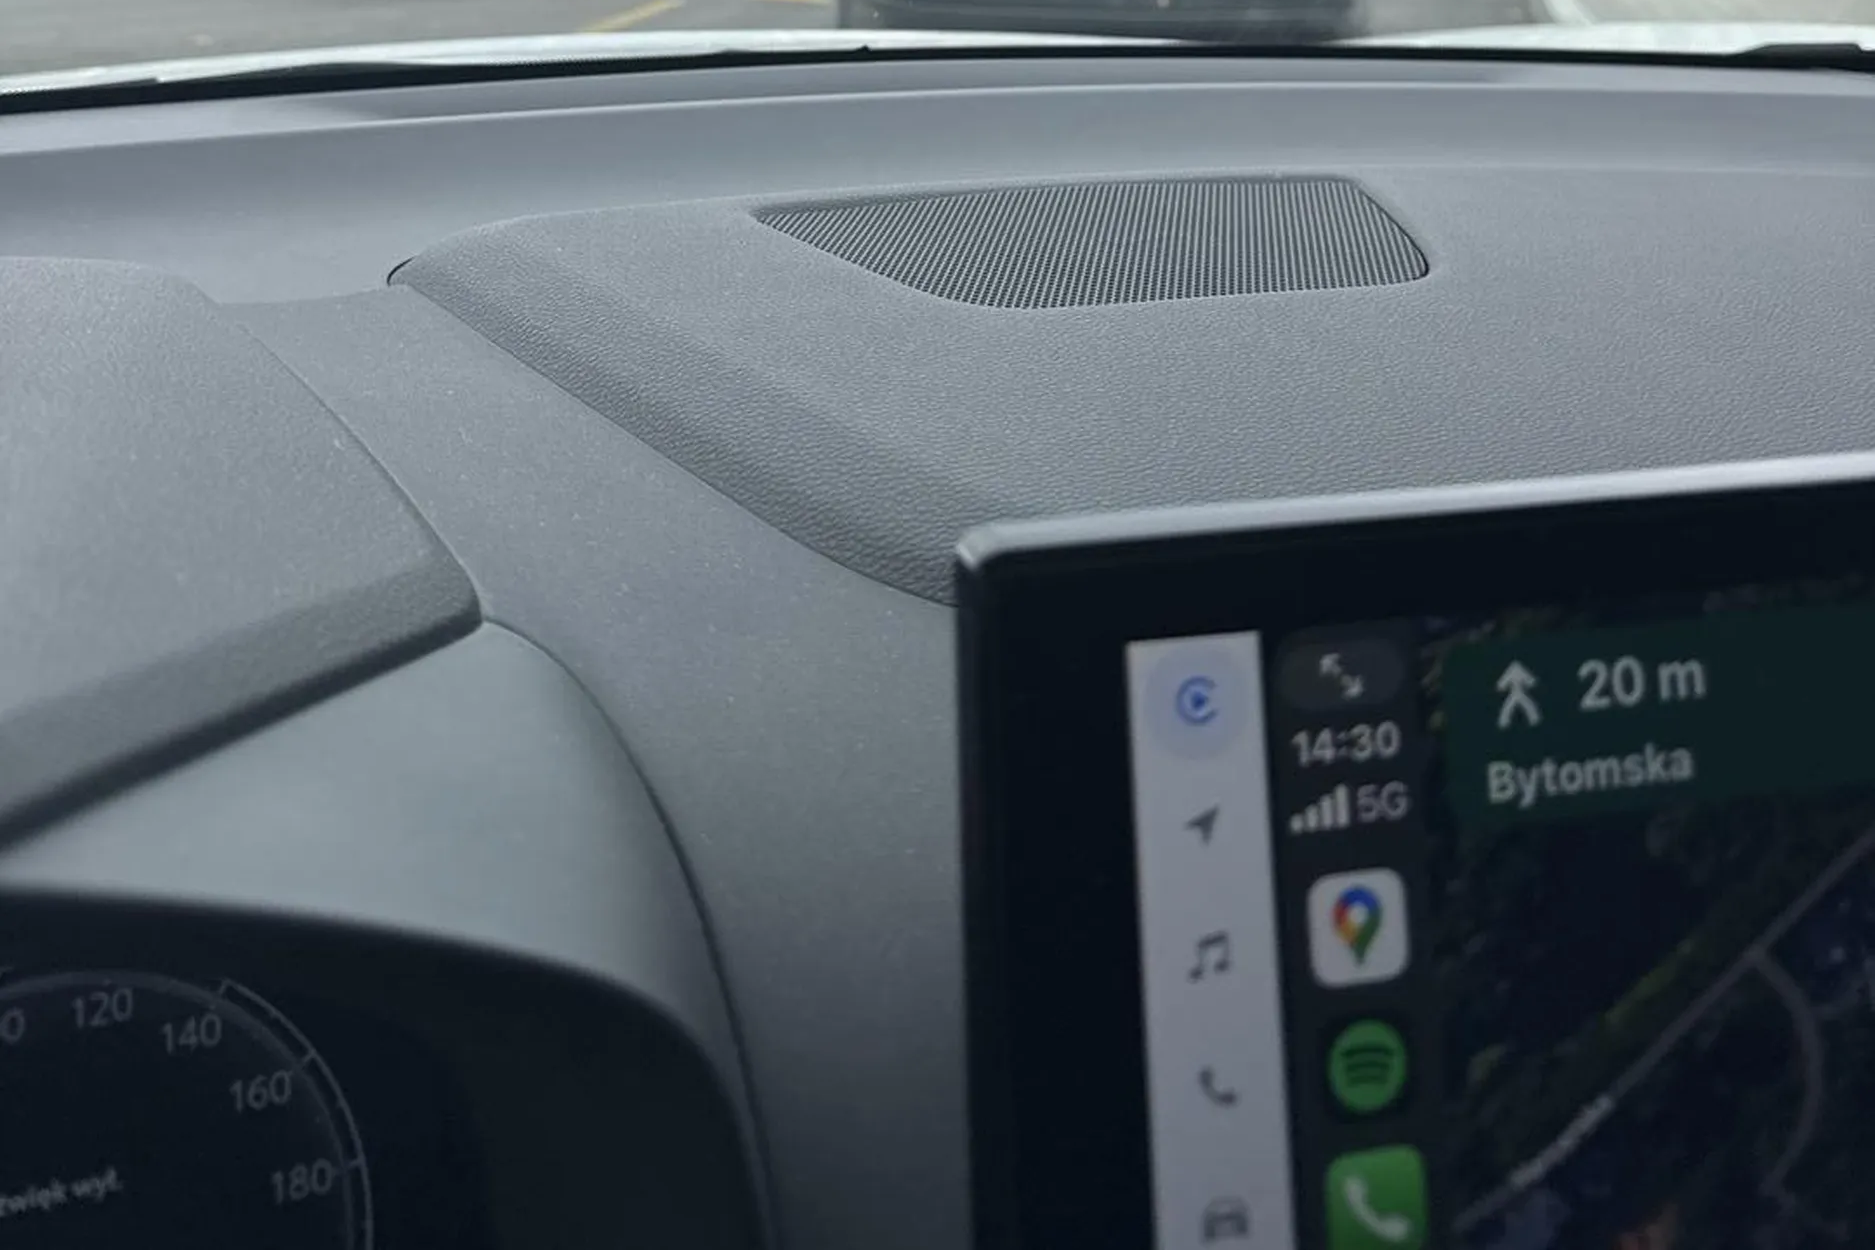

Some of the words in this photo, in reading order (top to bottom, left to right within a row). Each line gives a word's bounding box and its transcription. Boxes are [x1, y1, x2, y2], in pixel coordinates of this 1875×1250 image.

[1576, 654, 1646, 713] 20
[1656, 657, 1708, 702] m
[1290, 721, 1402, 767] 14:30
[1485, 742, 1696, 809] Bytomska
[1356, 782, 1409, 821] 5G
[71, 986, 134, 1030] 120
[161, 1012, 223, 1056] 140
[229, 1069, 293, 1114] 160
[270, 1158, 334, 1205] 180
